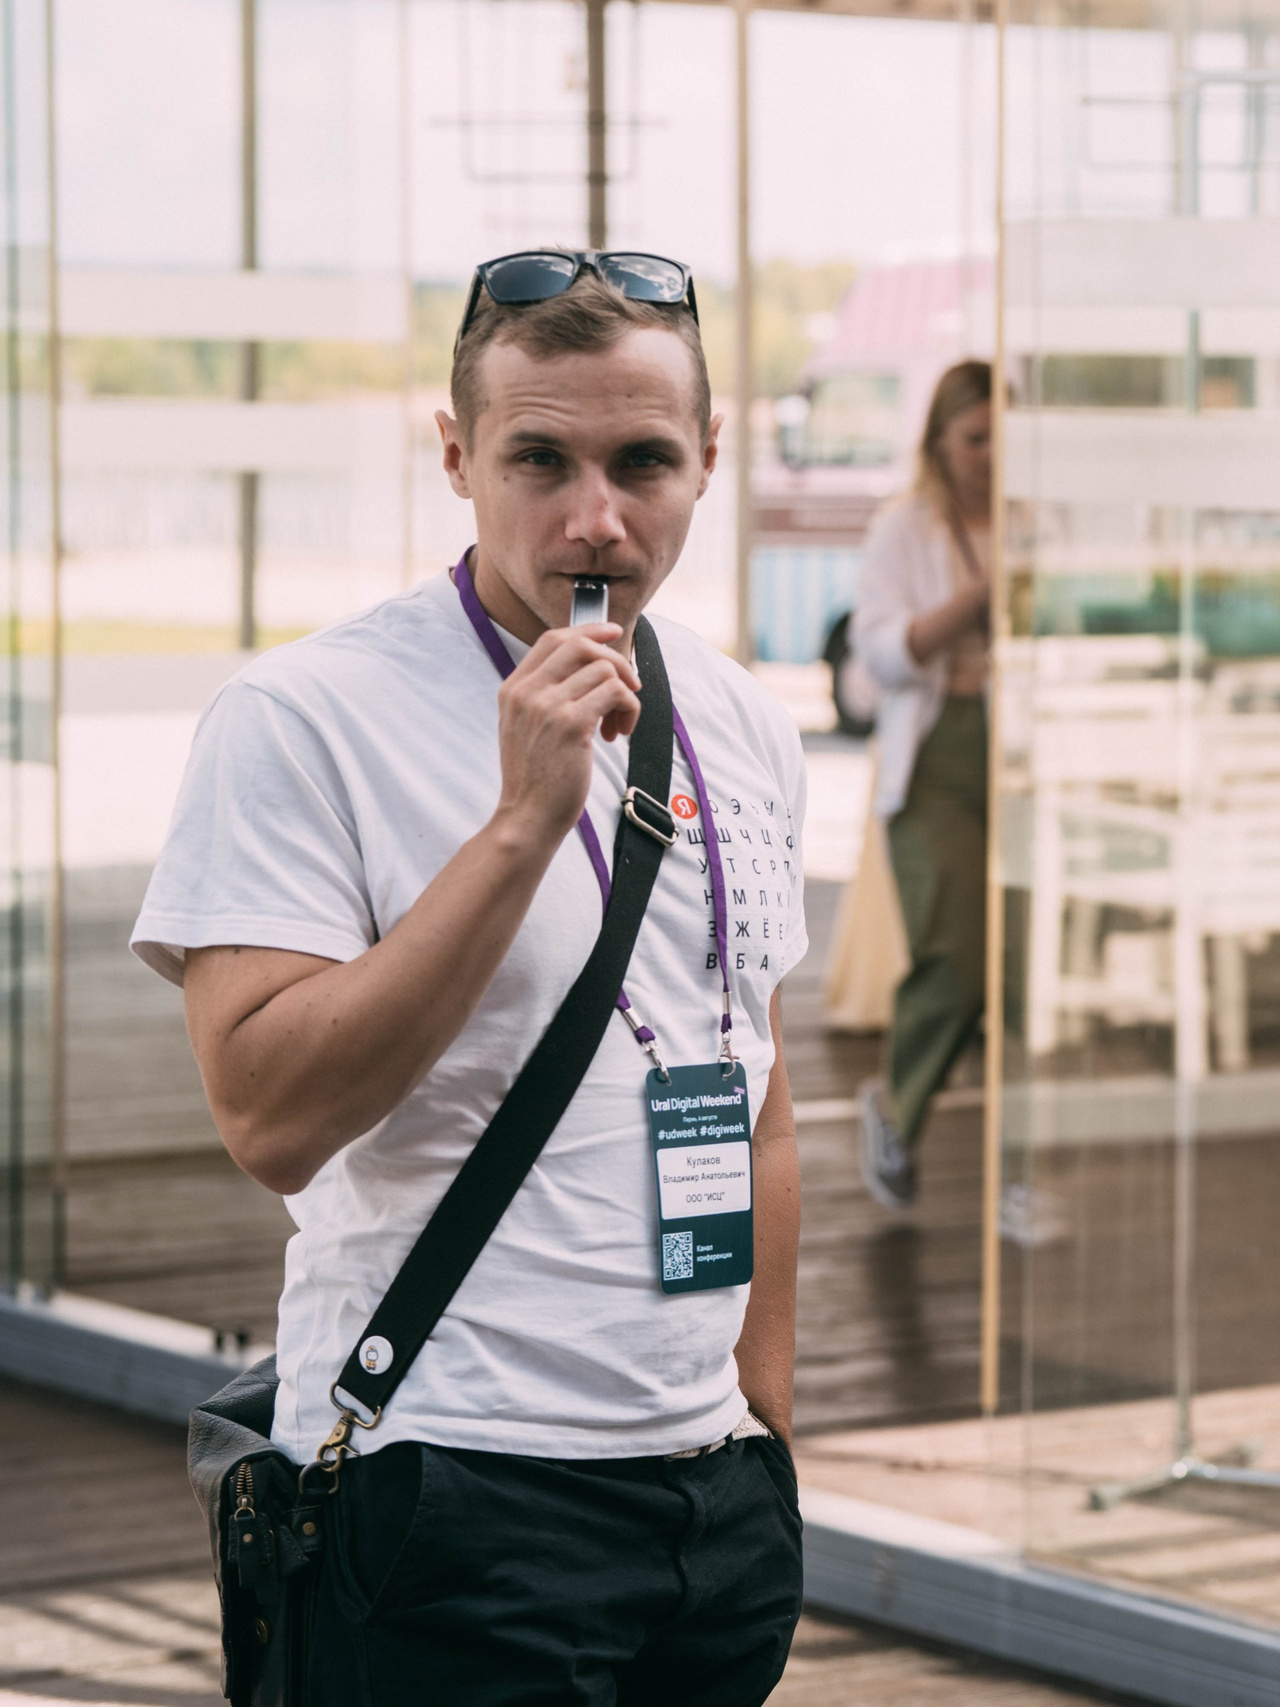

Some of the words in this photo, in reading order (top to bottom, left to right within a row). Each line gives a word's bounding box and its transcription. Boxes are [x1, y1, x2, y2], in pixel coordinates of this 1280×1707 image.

[677, 798, 692, 816] Я
[731, 799, 741, 814] Э
[740, 829, 751, 844] Ч
[761, 829, 772, 847] Ц
[698, 858, 708, 874] У
[726, 858, 737, 873] Т
[752, 859, 761, 874] С
[733, 889, 747, 904] М
[760, 890, 768, 906] Л
[736, 921, 750, 937] Ж
[763, 918, 770, 938] Ё
[706, 953, 717, 969] В
[736, 953, 745, 969] Б
[760, 954, 768, 971] А
[651, 1098, 670, 1112] Ural
[671, 1096, 700, 1112] Digital
[700, 1094, 741, 1108] Weekend
[658, 1127, 697, 1140] #udweek
[700, 1122, 744, 1138] #digiweek
[686, 1157, 720, 1168] Кулаков
[663, 1175, 699, 1184] Владимир
[701, 1171, 746, 1180] Анатольевич
[686, 1194, 702, 1203] ООО
[704, 1192, 725, 1201] "ИСЦ"
[697, 1252, 732, 1262] конференции
